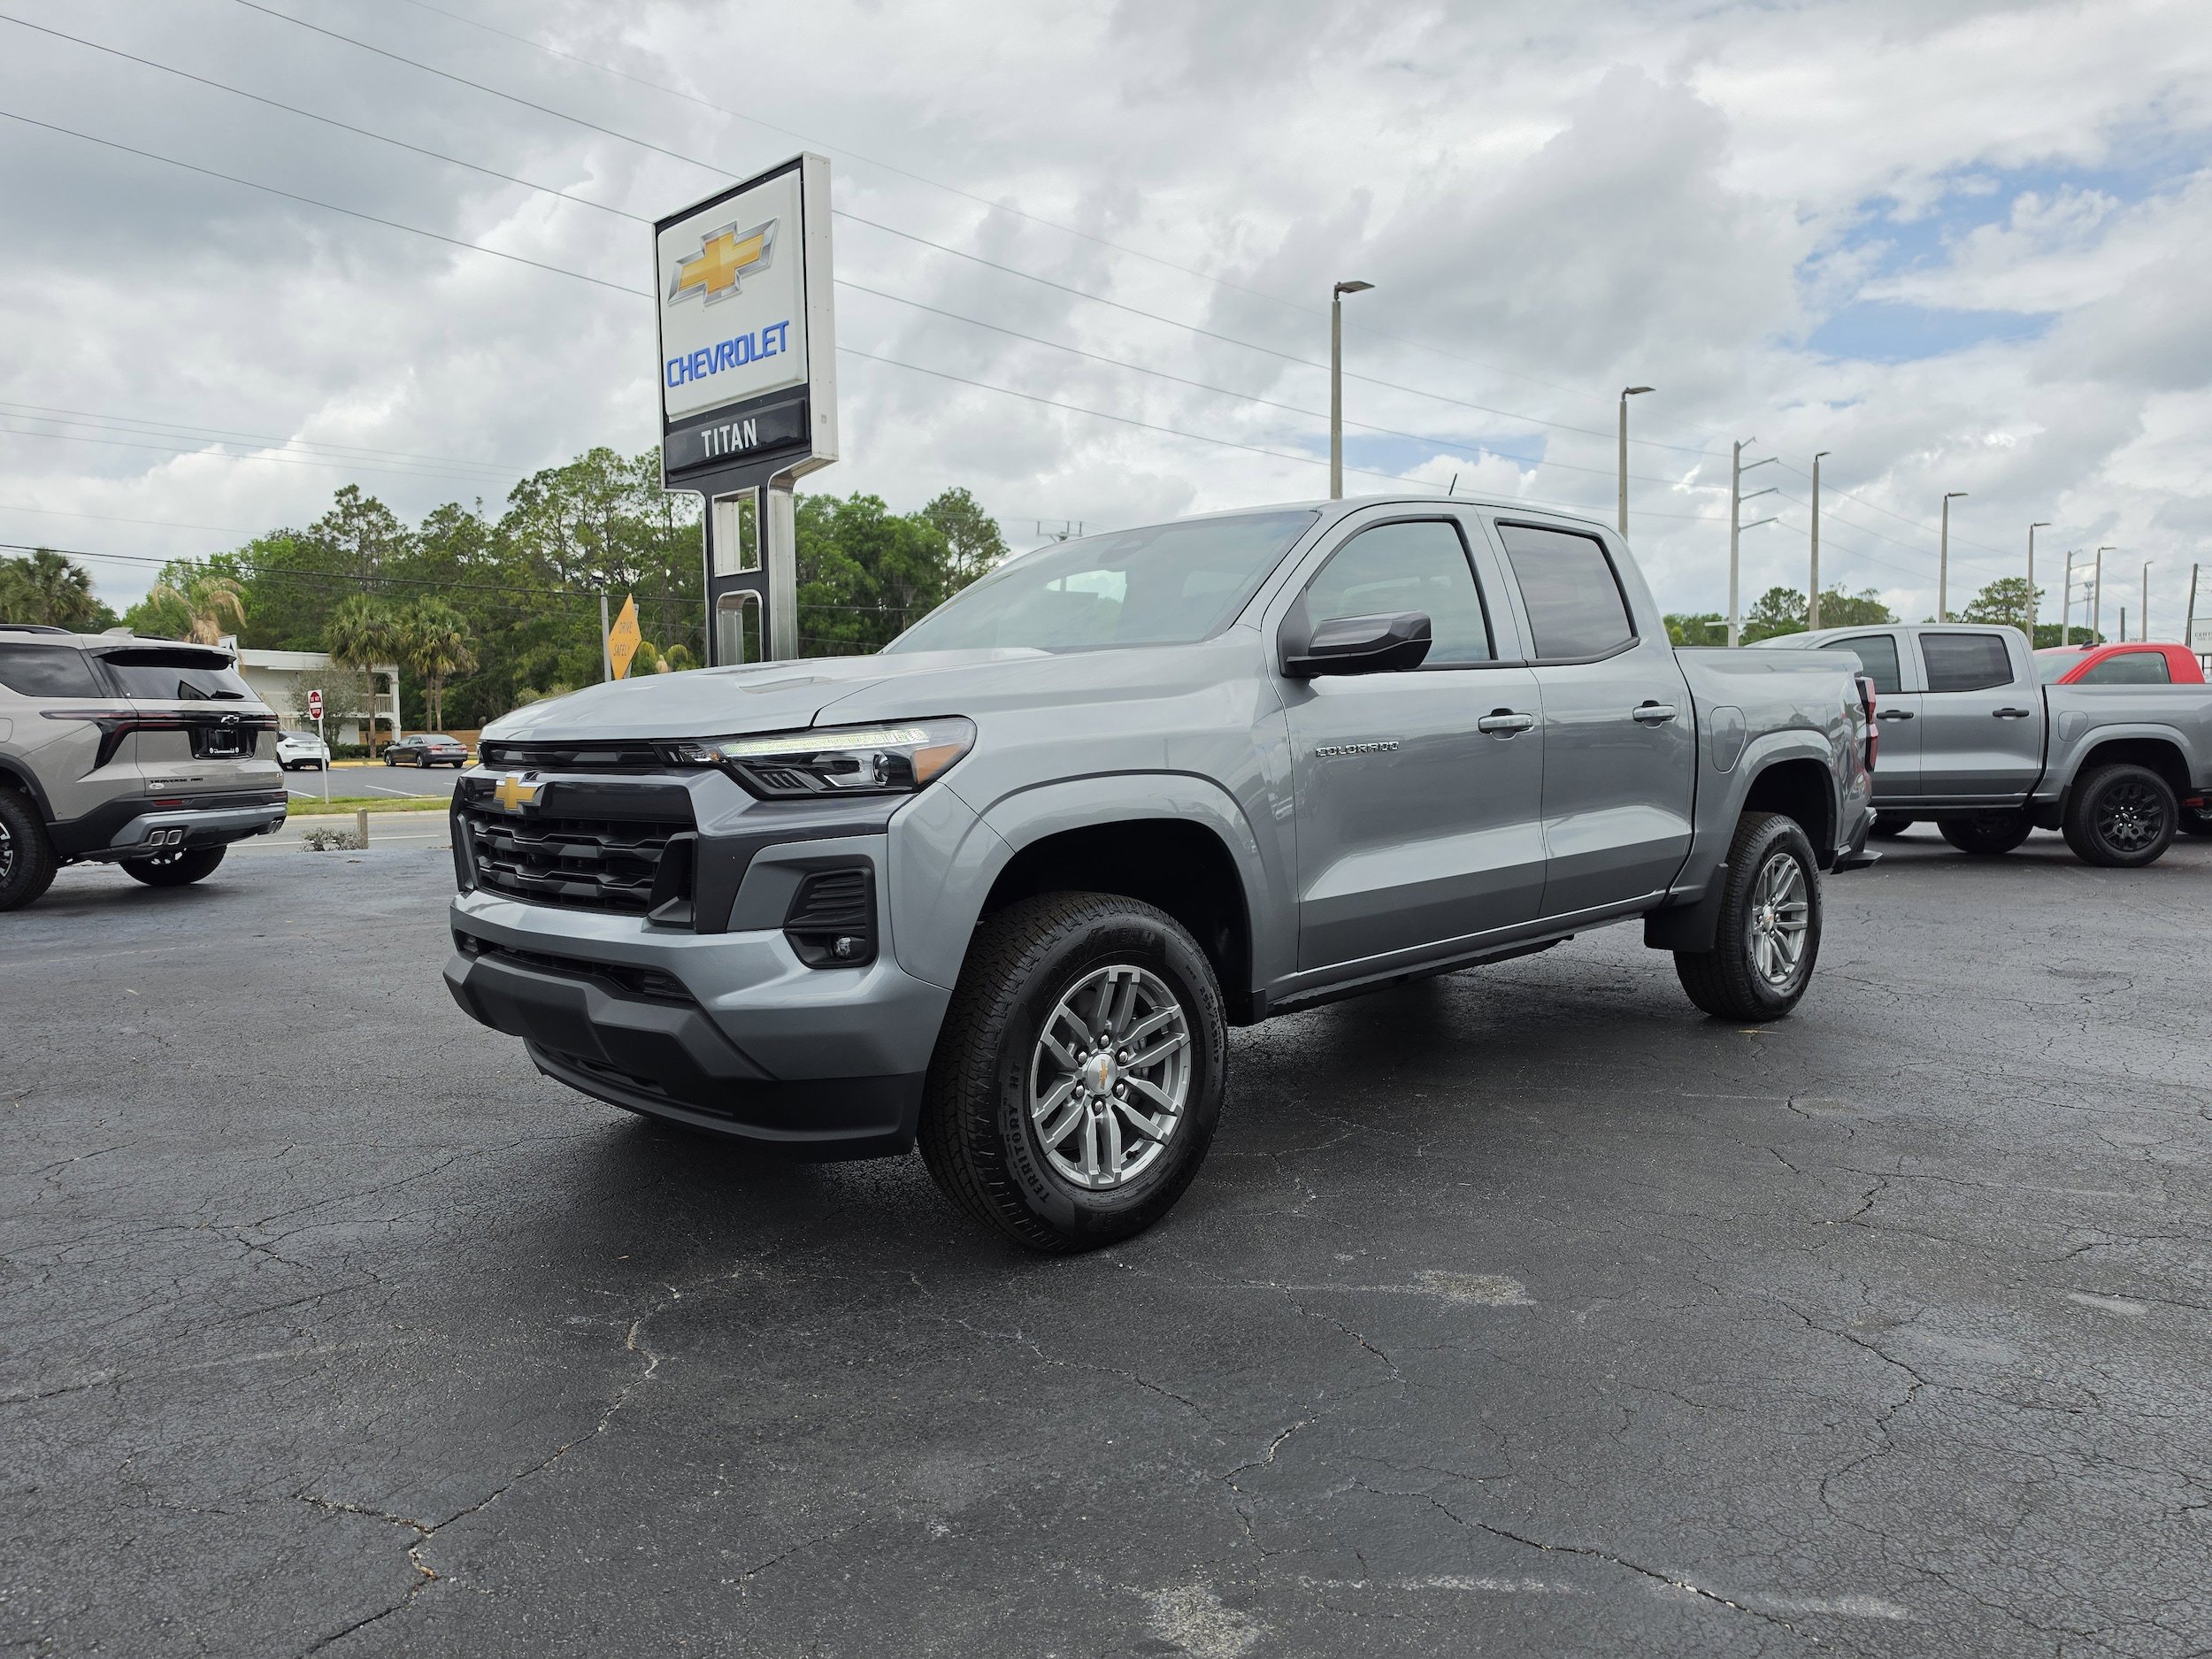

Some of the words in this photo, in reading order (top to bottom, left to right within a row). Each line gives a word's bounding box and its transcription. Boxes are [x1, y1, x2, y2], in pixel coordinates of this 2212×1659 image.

[666, 319, 789, 388] CHEVROLET
[701, 418, 758, 458] TITAN
[1316, 741, 1400, 757] COLORADO
[1009, 1103, 1051, 1204] TERRITORY
